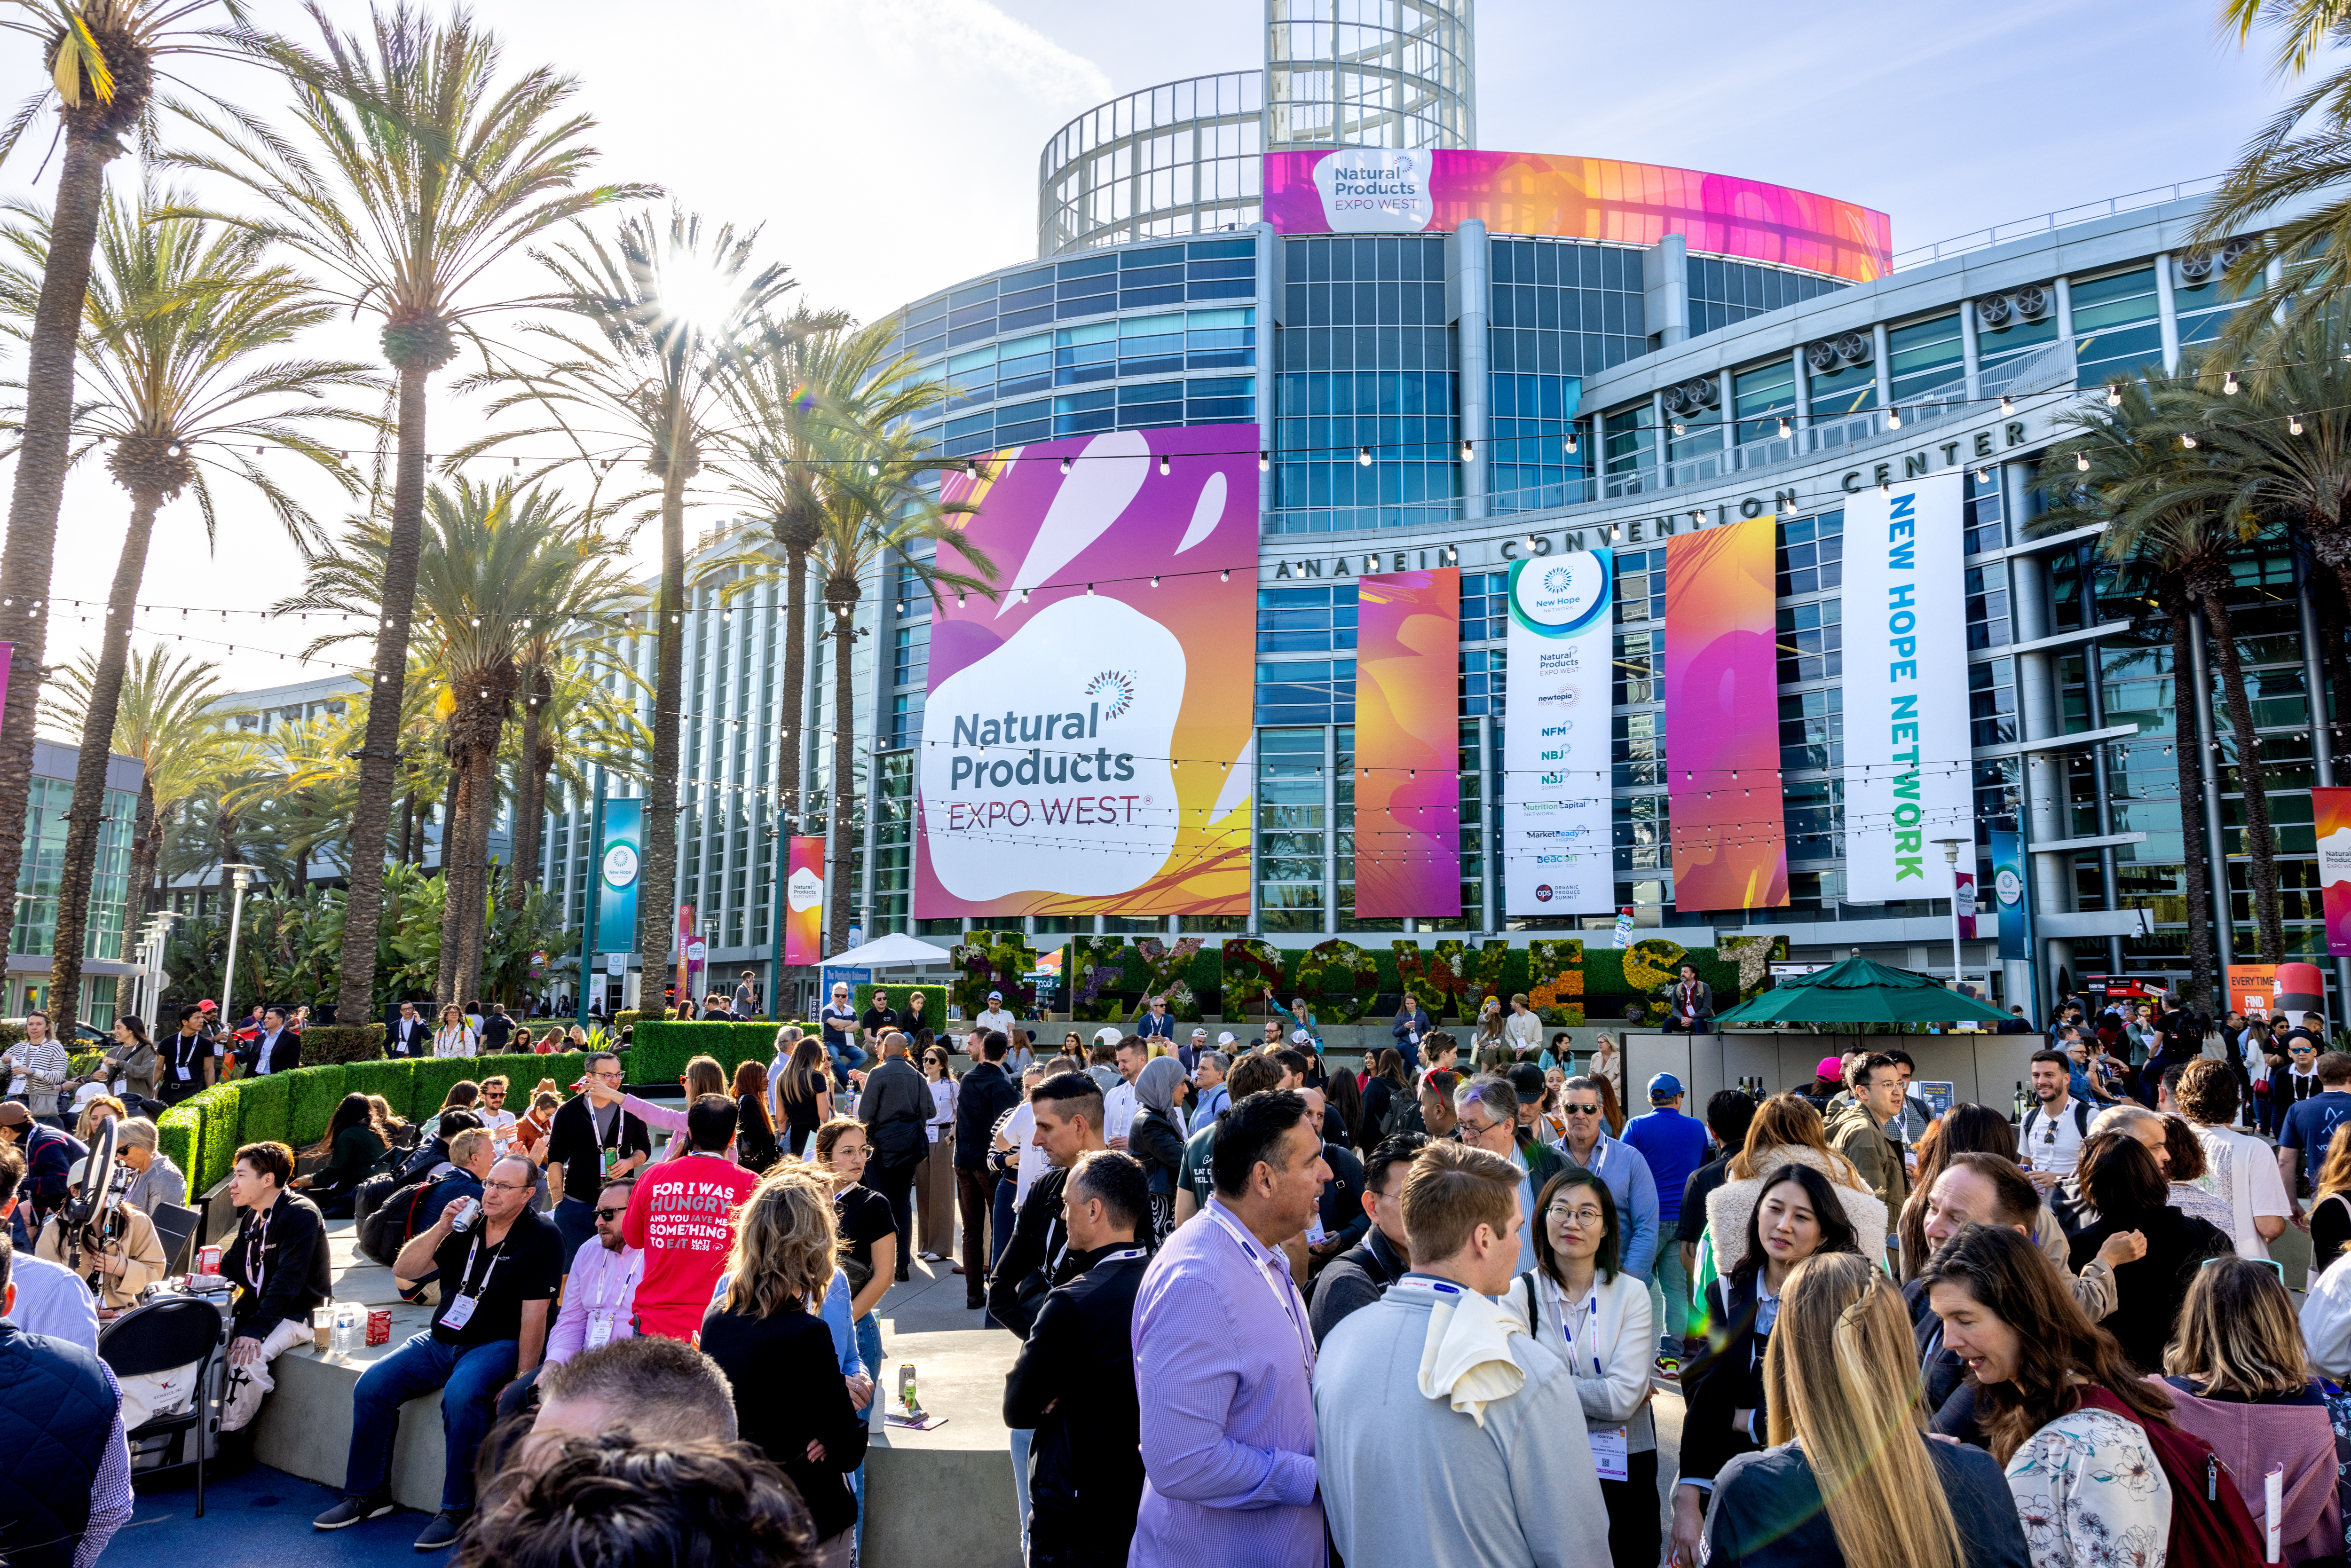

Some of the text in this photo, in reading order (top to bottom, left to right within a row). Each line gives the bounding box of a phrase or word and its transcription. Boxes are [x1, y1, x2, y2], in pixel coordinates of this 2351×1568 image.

[1335, 166, 1400, 180] Natural
[1335, 181, 1415, 196] Products
[1336, 199, 1418, 210] EXPO WEST
[1276, 421, 2025, 579] ANAHEIM CONVENTION CENTER
[1557, 597, 1580, 606] Hope
[1540, 652, 1571, 661] Natural
[1540, 659, 1578, 669] Products
[1888, 493, 1924, 882] NEW HOPE NETWORK
[1538, 693, 1572, 705] newtopia
[953, 702, 1099, 749] Natural
[1542, 726, 1566, 737] NFM
[1541, 750, 1564, 761] NBJ
[951, 747, 1135, 790] Products
[1541, 774, 1563, 785] NBJ
[1560, 801, 1586, 811] Capital
[949, 799, 1031, 831] EXPO
[1537, 854, 1577, 863] Beacon
[835, 970, 852, 982] Perfectly
[852, 971, 868, 981] Balanced
[2244, 995, 2264, 1008] FIND
[653, 1182, 734, 1199] FOR I WAS
[650, 1196, 732, 1214] HUNGRY
[715, 1217, 728, 1227] ME
[650, 1224, 727, 1239] SOMETHING
[650, 1237, 664, 1249] TO
[666, 1238, 688, 1249] EAT
